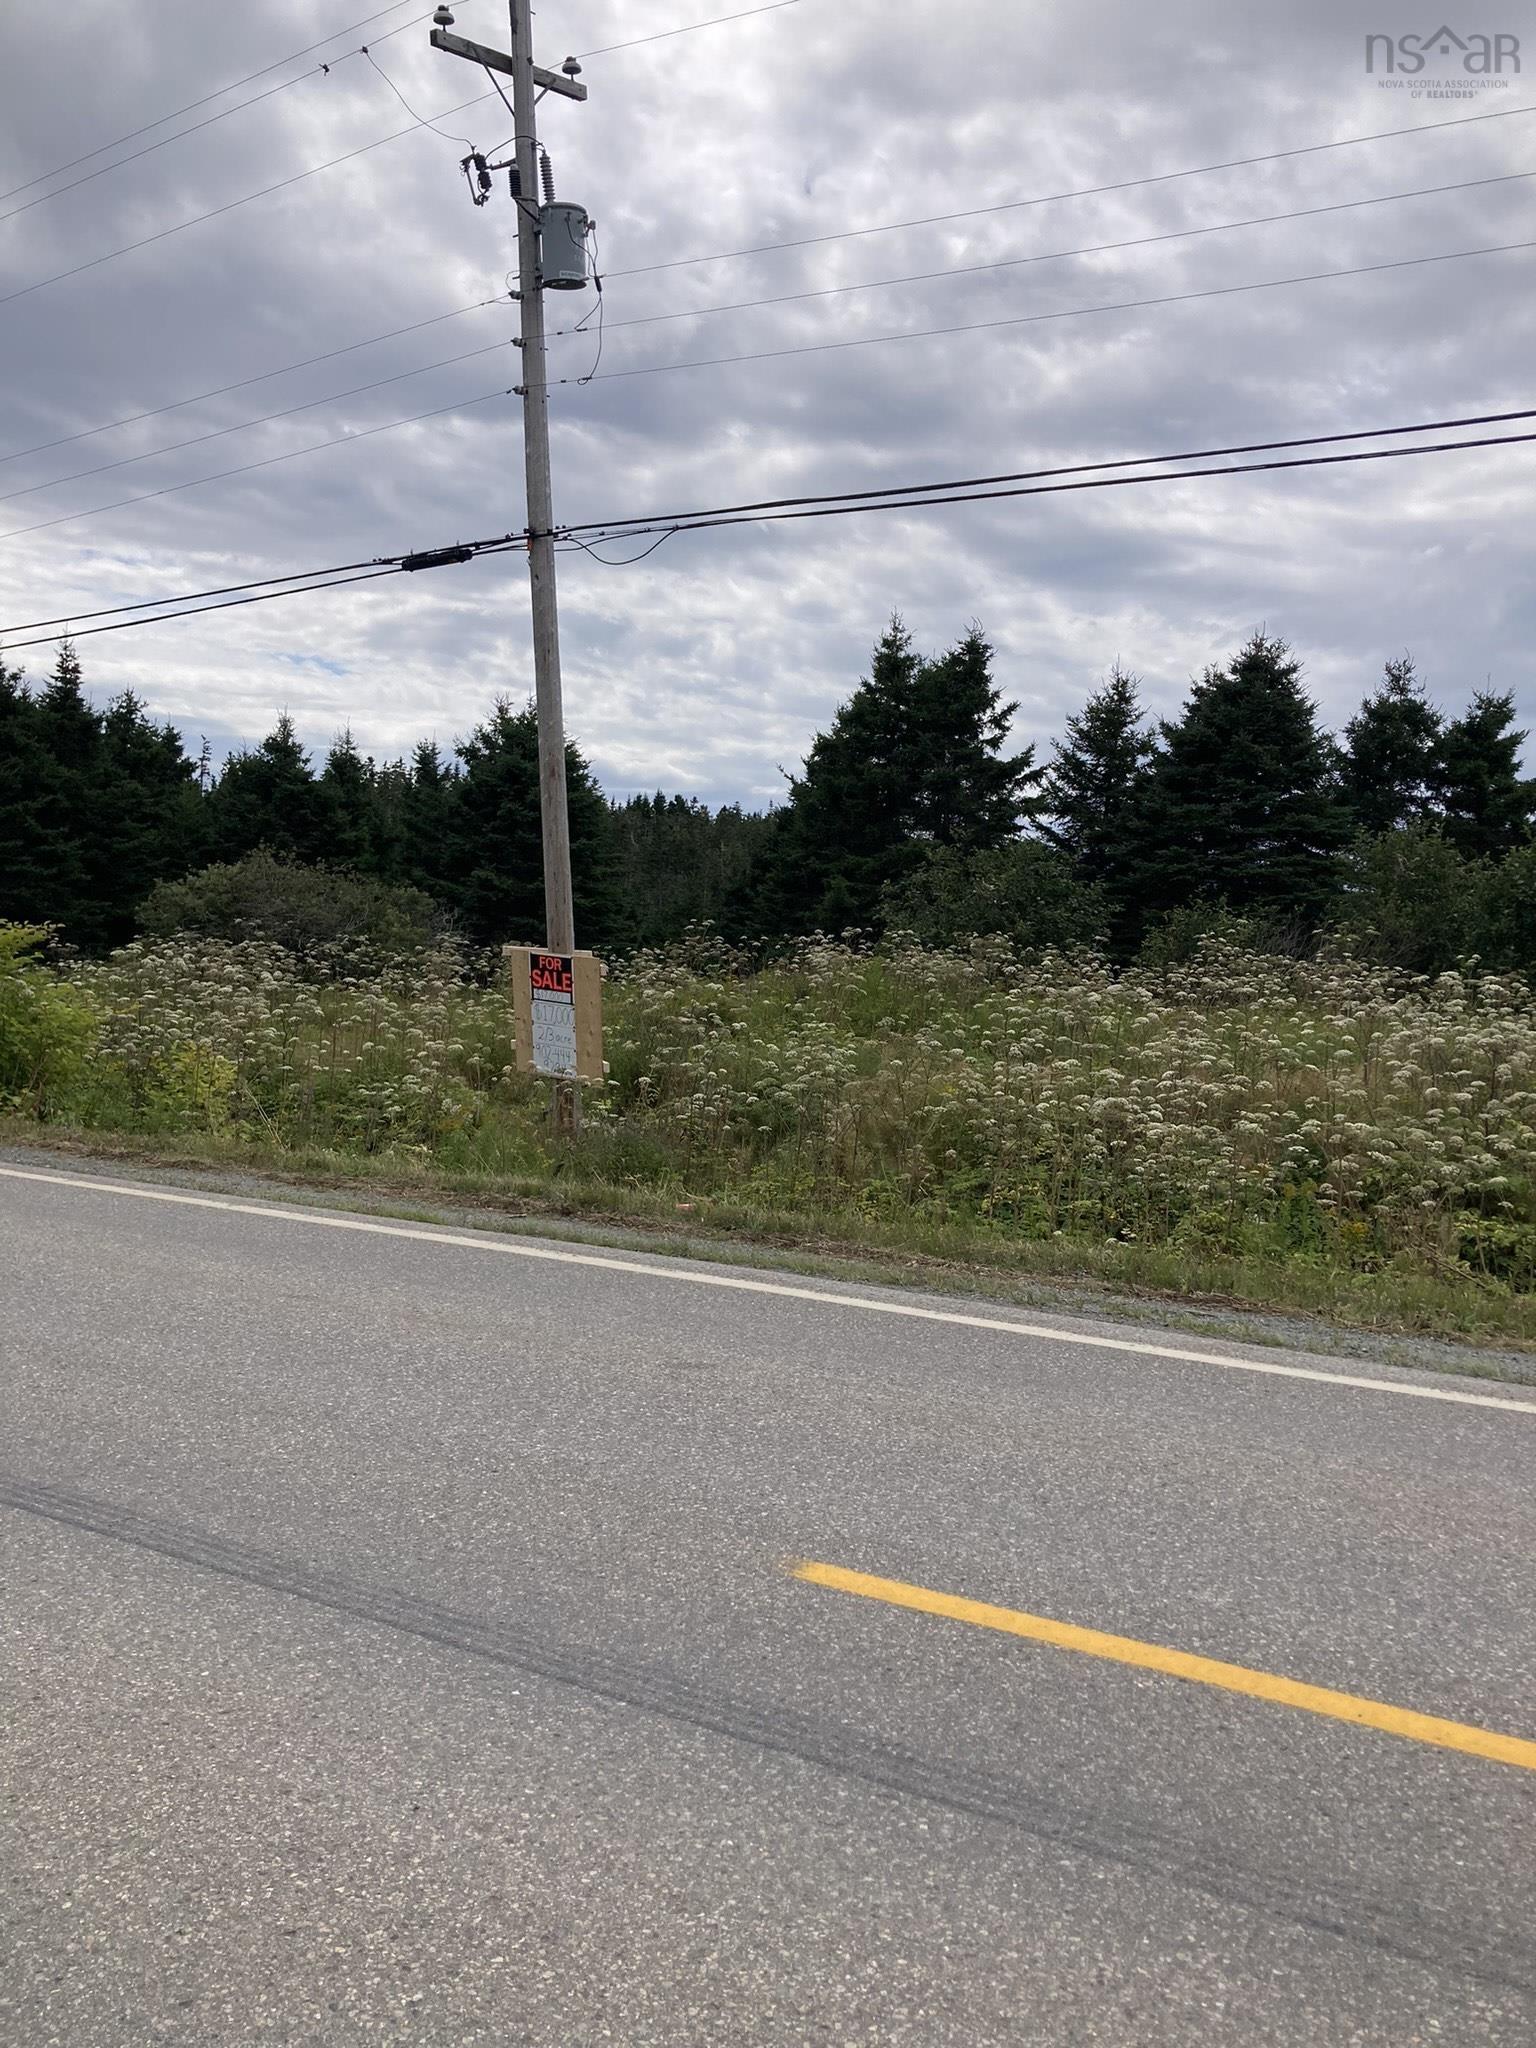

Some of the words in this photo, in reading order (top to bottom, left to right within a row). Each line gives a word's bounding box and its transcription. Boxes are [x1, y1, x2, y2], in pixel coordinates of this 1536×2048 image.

[539, 956, 562, 971] FOR
[532, 970, 572, 991] SALE
[536, 1004, 574, 1025] $17,000
